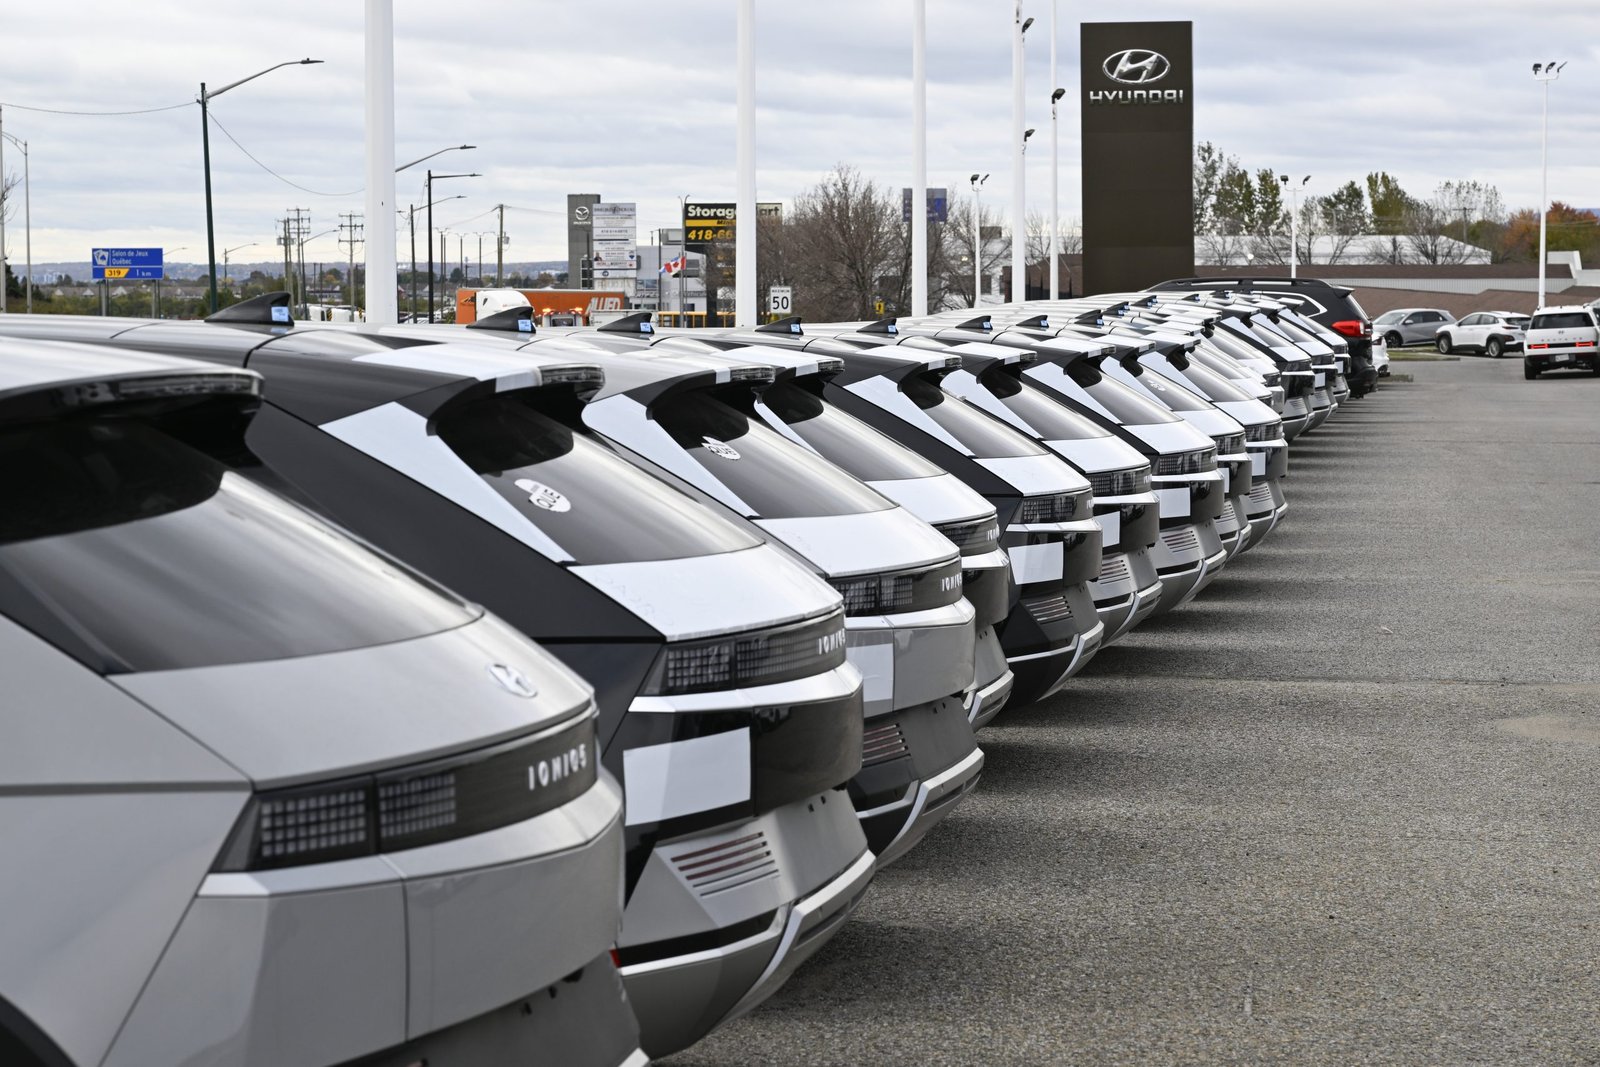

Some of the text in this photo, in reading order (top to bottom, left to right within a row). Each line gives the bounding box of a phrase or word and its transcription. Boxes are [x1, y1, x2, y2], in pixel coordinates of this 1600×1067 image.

[1089, 90, 1184, 104] HYUNDAI
[688, 205, 736, 219] Storag
[107, 269, 121, 277] 319
[772, 296, 789, 310] 50
